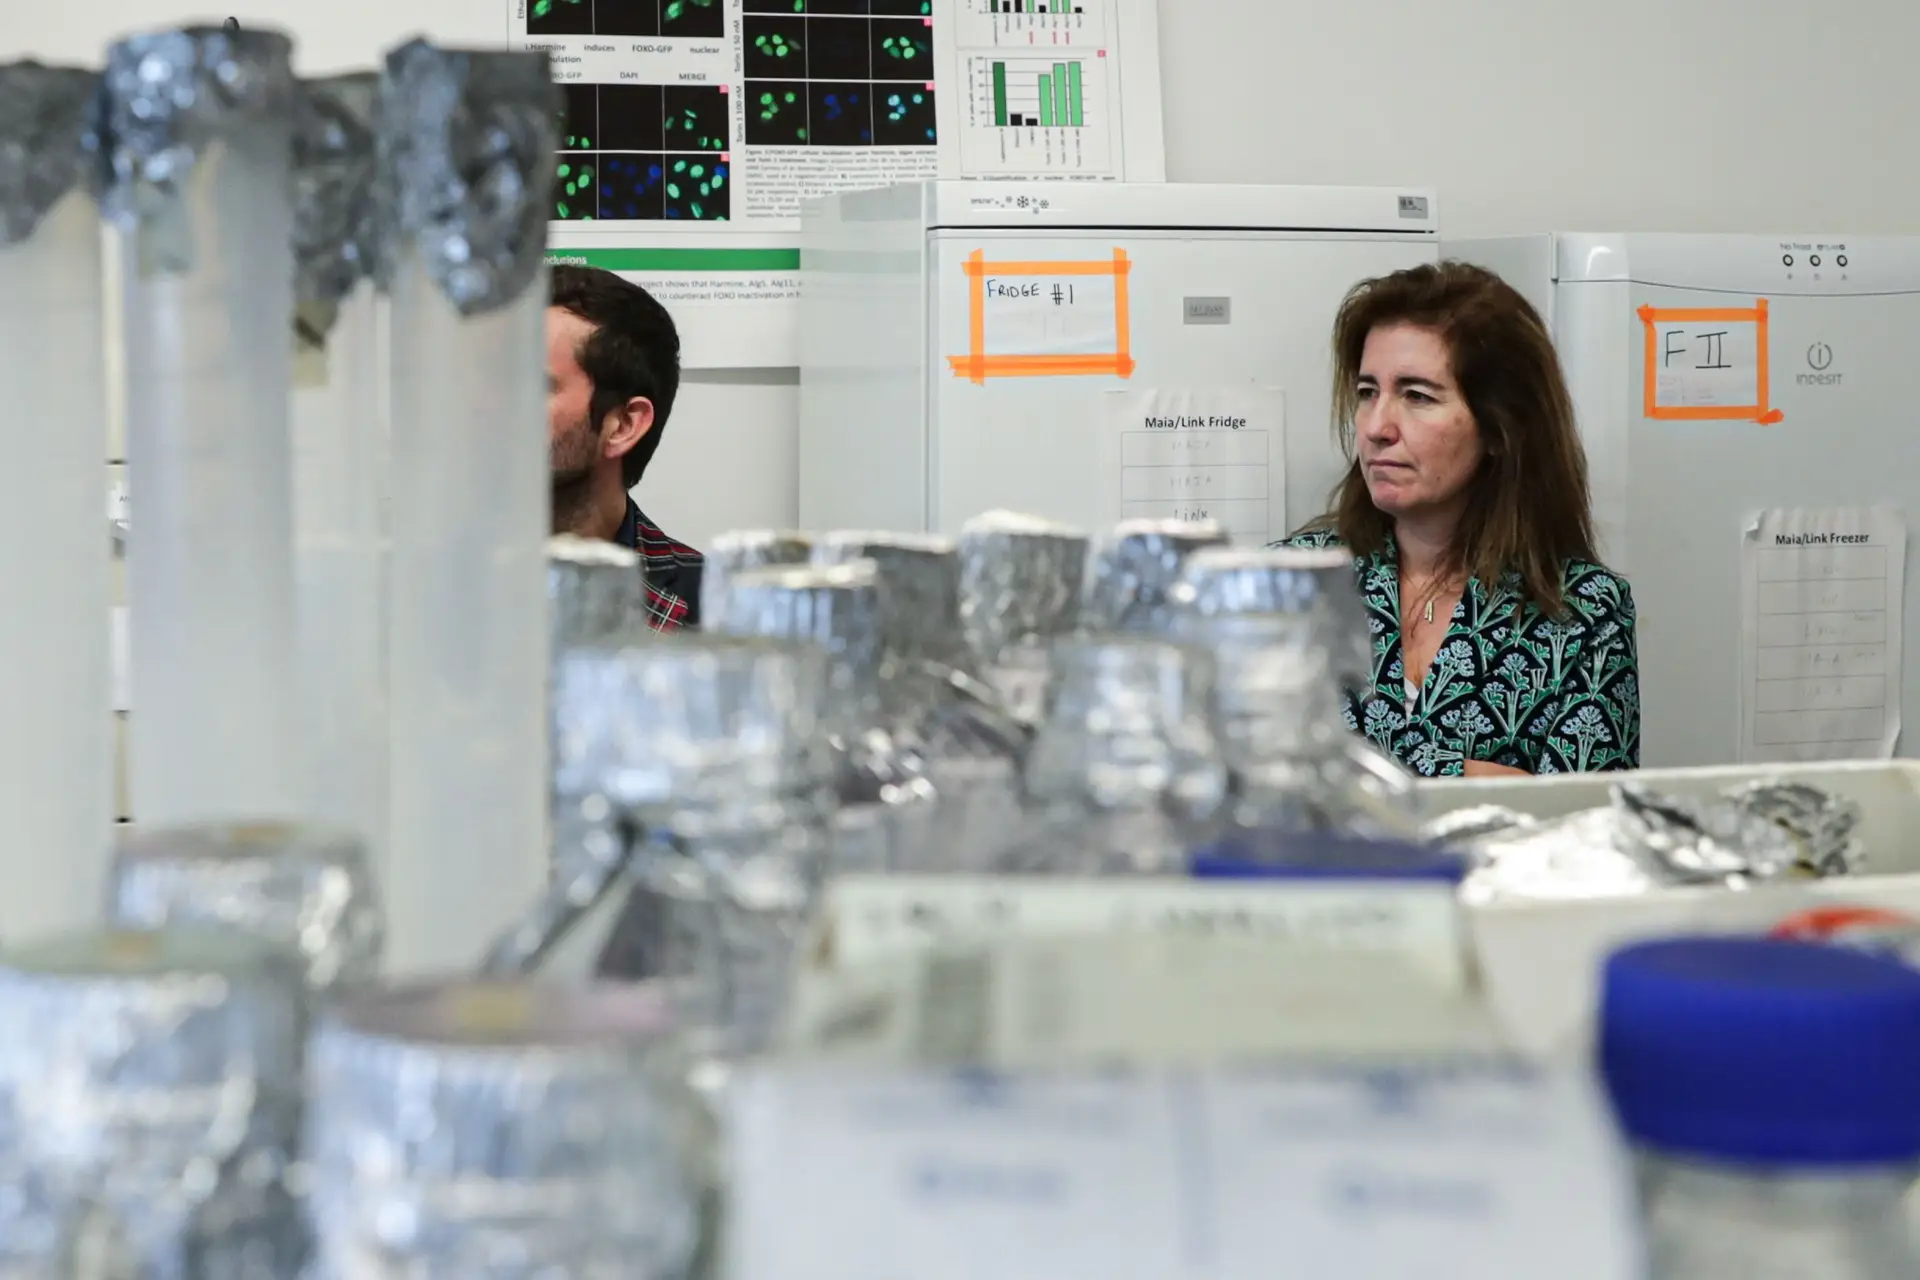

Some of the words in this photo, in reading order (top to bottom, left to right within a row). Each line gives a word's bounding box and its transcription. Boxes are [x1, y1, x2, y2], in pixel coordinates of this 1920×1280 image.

[584, 43, 615, 53] induces
[632, 45, 673, 54] FOXO-GFP
[690, 46, 720, 54] nuclear
[620, 72, 639, 80] DAPI
[679, 73, 707, 82] MERGE
[665, 280, 689, 289] shows
[691, 280, 707, 288] that
[669, 292, 711, 300] counteract
[738, 291, 786, 300] inactivation
[987, 279, 1040, 298] FRIDGE
[1050, 283, 1074, 305] #1
[1666, 330, 1687, 368] F
[1145, 416, 1206, 430] Maia/Link
[1209, 416, 1247, 431] Fridge
[1775, 533, 1828, 547] Maia/Link
[1830, 532, 1870, 544] Freezer
